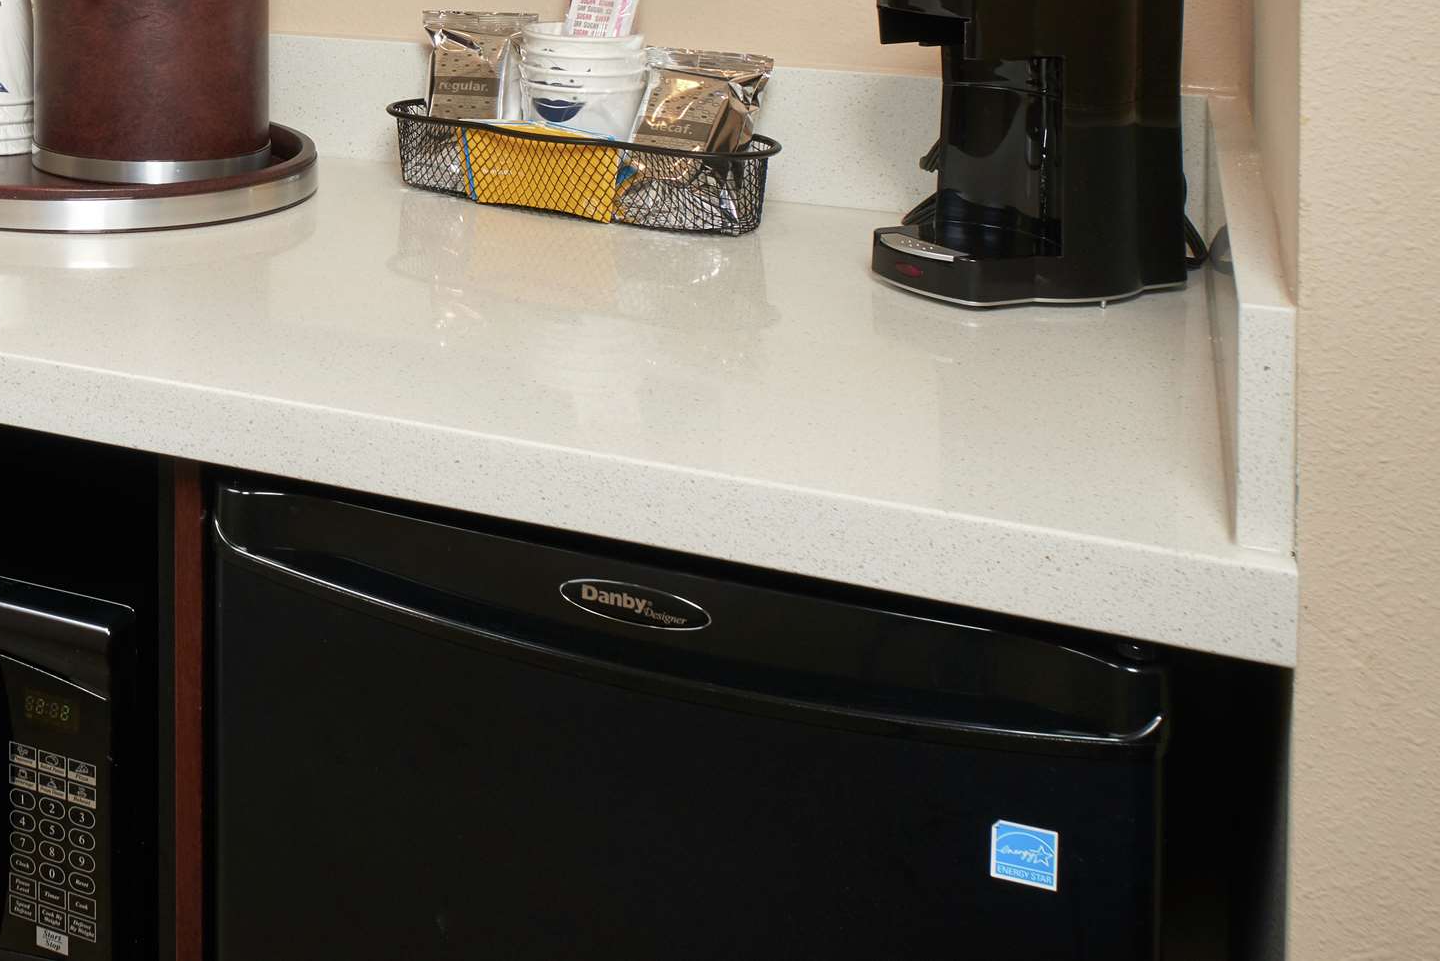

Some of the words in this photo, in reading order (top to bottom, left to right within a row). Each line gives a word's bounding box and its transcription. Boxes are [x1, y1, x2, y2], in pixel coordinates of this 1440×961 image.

[439, 81, 488, 92] regular.
[650, 120, 693, 135] decaf.
[581, 584, 648, 614] Danby
[645, 608, 687, 625] Designer
[20, 794, 25, 805] 1
[49, 803, 55, 814] 2
[19, 816, 26, 826] 4
[79, 813, 85, 823] 3
[49, 825, 55, 836] 5
[19, 837, 25, 848] 7
[79, 834, 85, 845] 6
[49, 847, 55, 857] 8
[79, 856, 85, 867] 9
[49, 868, 55, 879] 0
[997, 865, 1029, 880] ENERGY
[1030, 871, 1052, 884] STAR
[43, 929, 62, 941] Start
[46, 940, 61, 950] Stop
